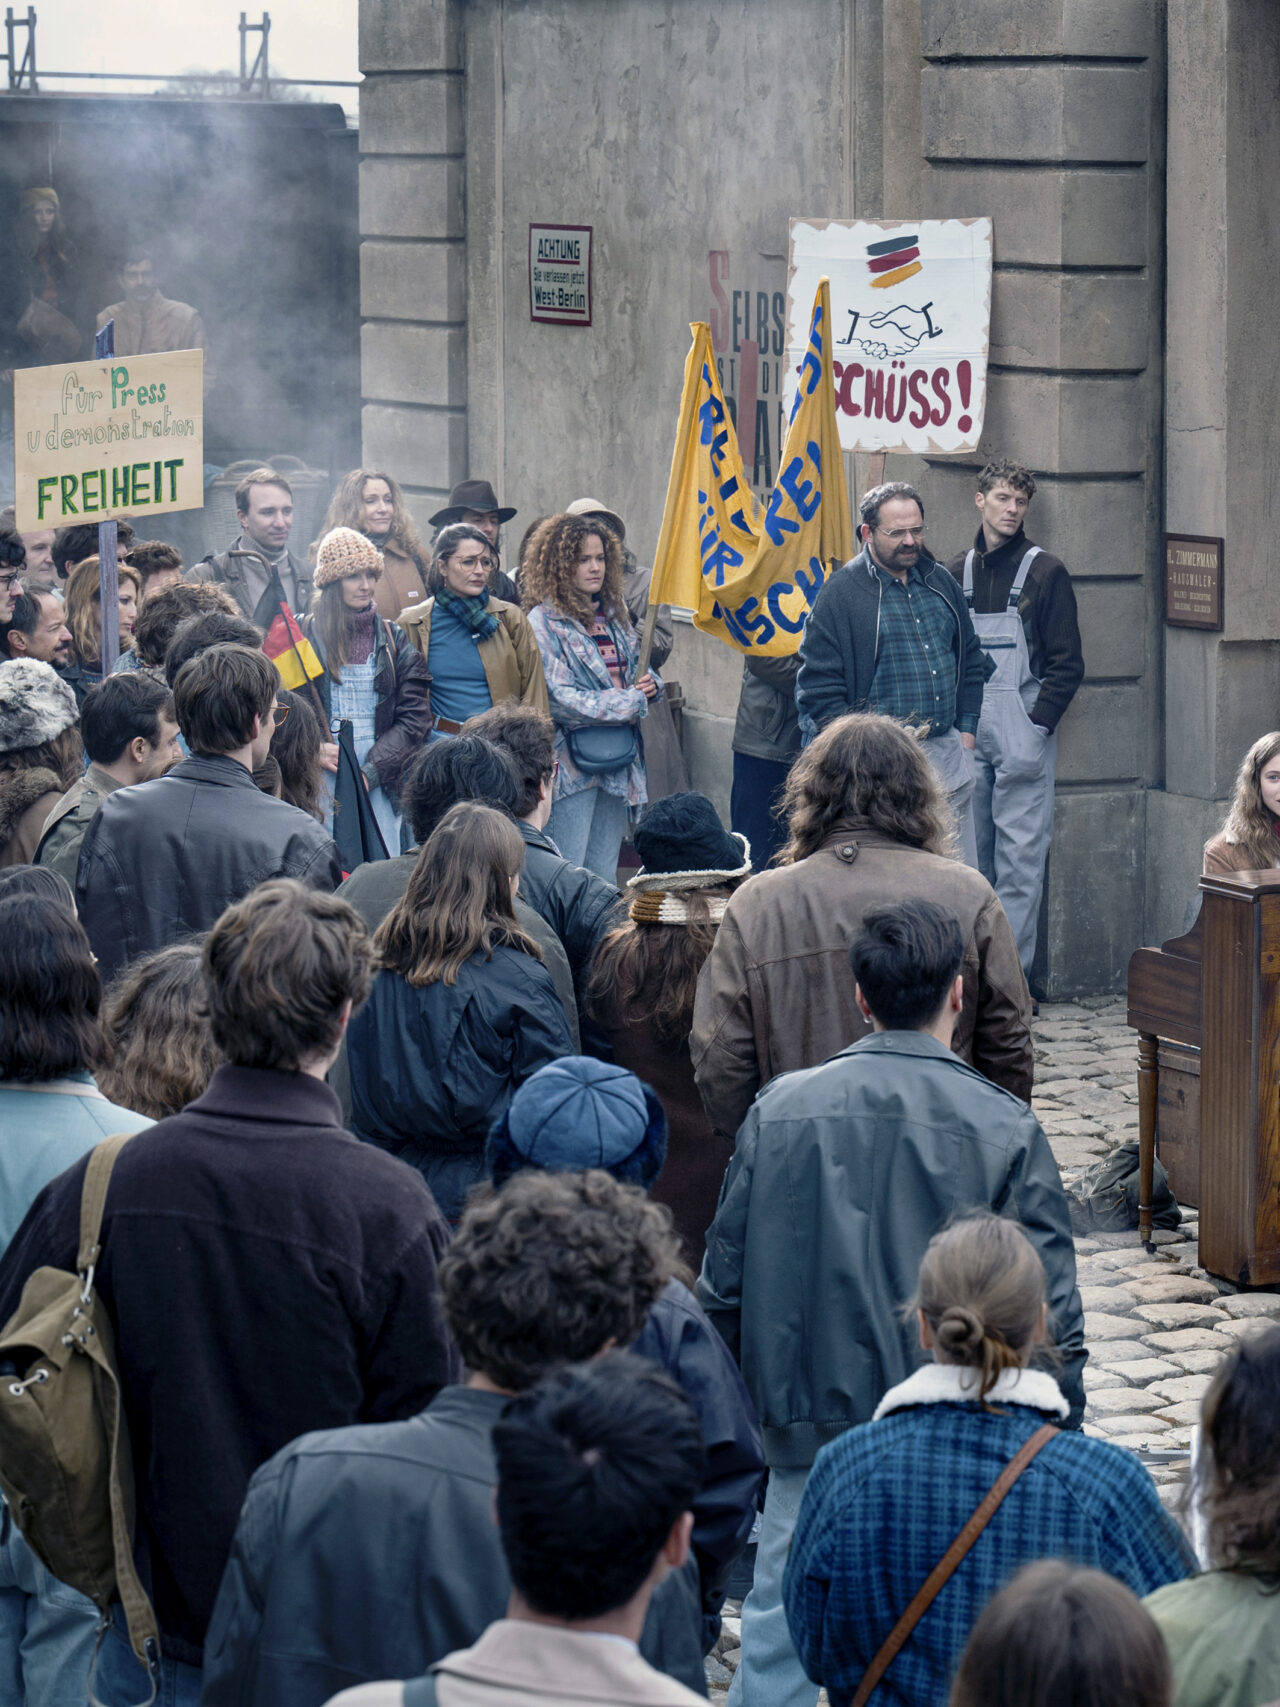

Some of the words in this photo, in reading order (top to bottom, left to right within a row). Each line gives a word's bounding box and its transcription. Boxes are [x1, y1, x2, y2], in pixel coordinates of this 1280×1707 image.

[538, 238, 580, 260] ACHTUNG
[535, 286, 586, 309] West-Berlin
[543, 269, 570, 284] verlassen
[570, 270, 585, 287] jetzt
[111, 366, 166, 409] Press
[796, 359, 973, 434] SCHÜSS!
[45, 404, 195, 451] demonstration
[37, 458, 185, 520] FREIHEIT
